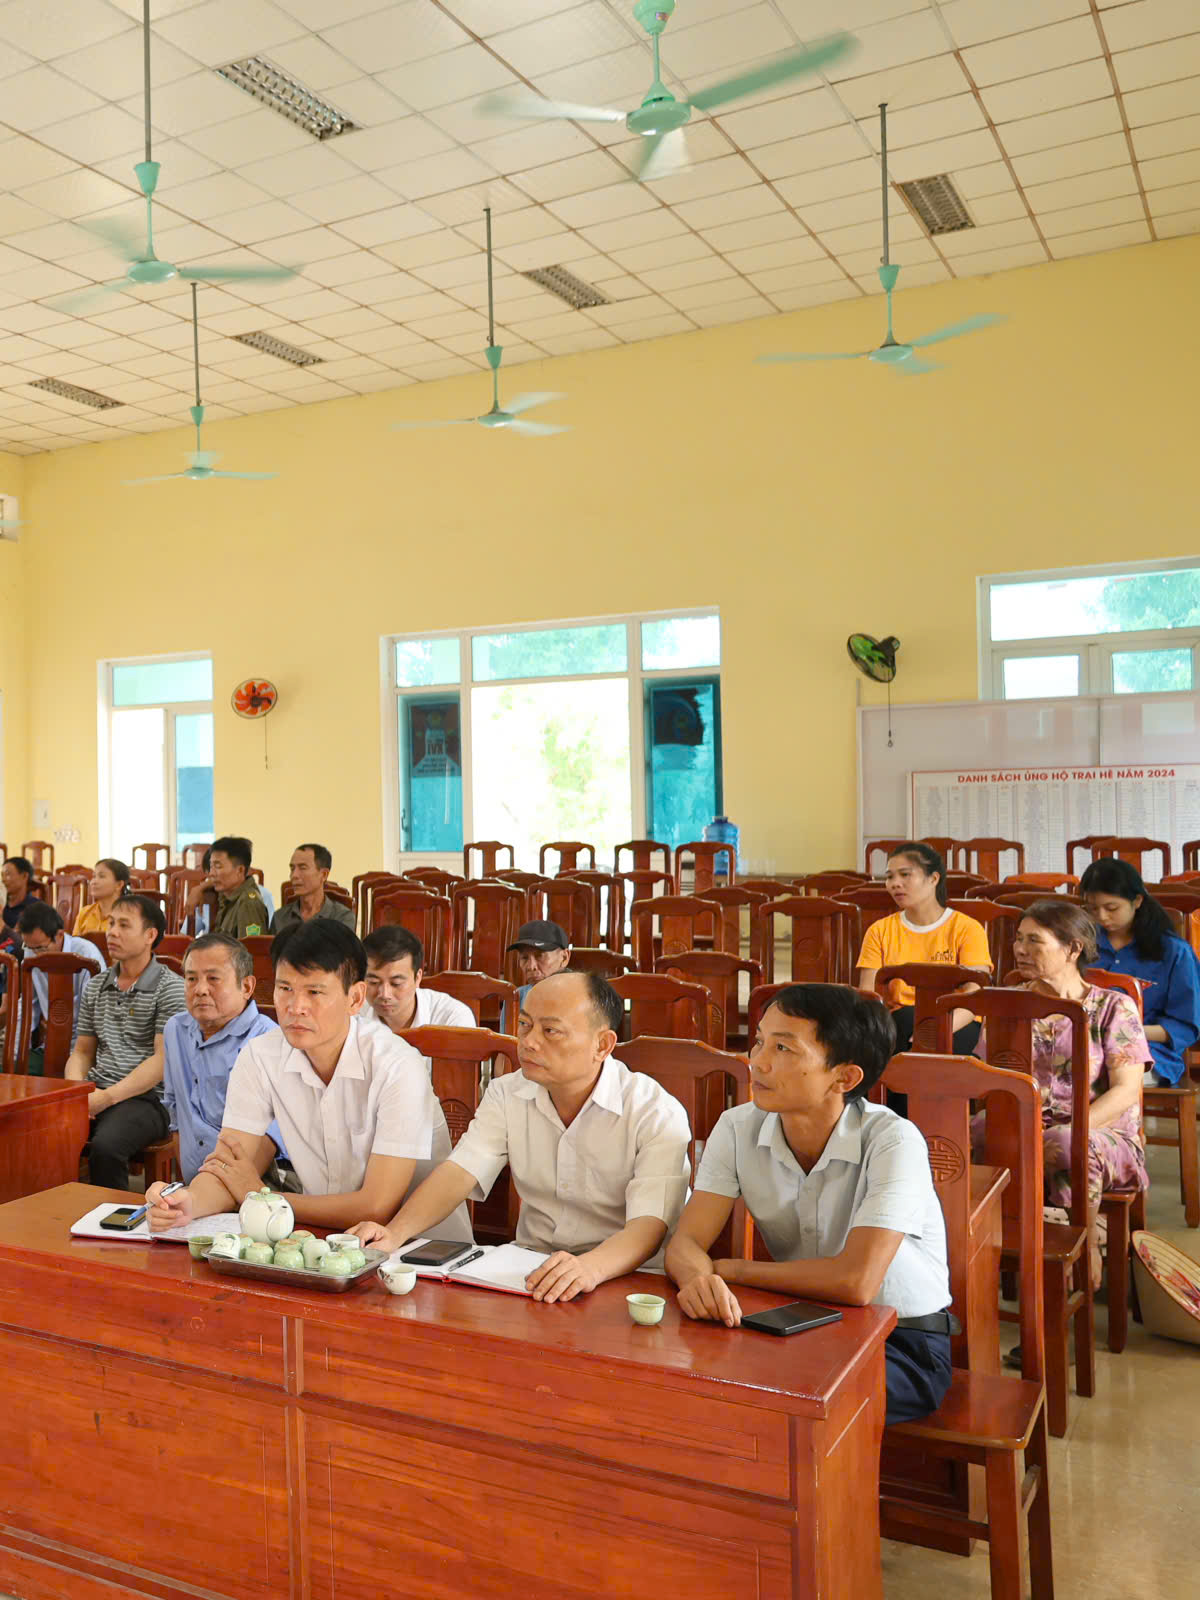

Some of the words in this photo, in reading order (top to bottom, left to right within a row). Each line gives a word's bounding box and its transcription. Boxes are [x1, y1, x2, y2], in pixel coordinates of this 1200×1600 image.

[957, 774, 988, 784] DANH
[991, 771, 1021, 783] SÁCH
[1051, 770, 1069, 782] HỘ
[1072, 771, 1097, 783] TRẠI
[1147, 768, 1176, 779] 2024
